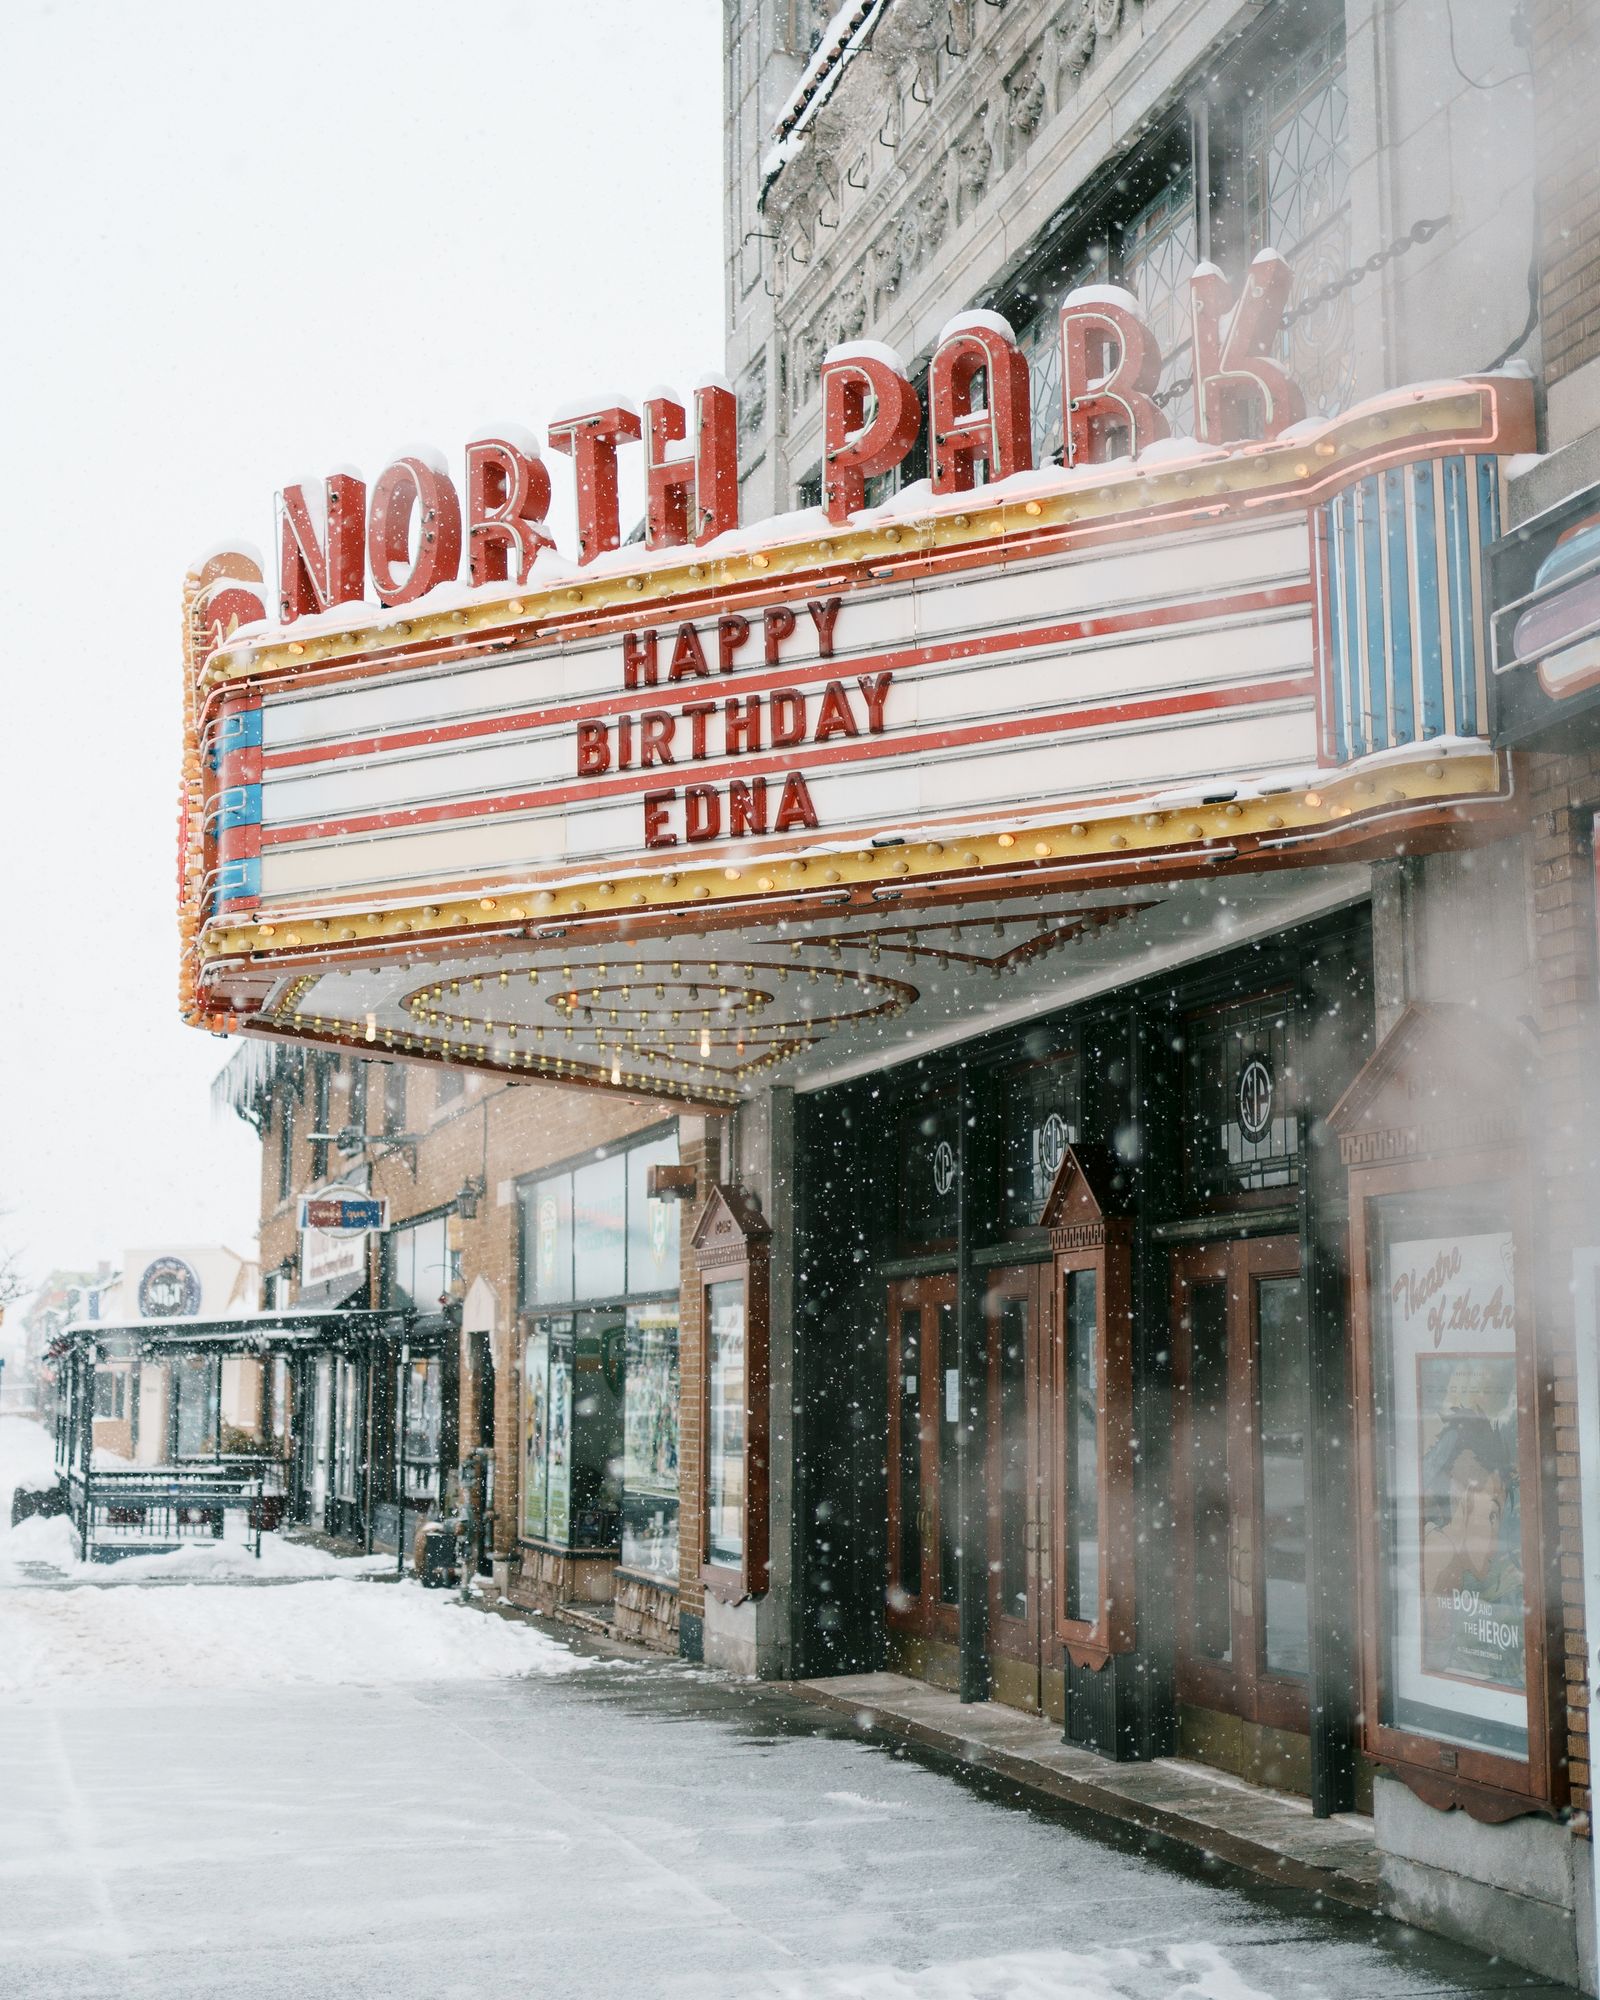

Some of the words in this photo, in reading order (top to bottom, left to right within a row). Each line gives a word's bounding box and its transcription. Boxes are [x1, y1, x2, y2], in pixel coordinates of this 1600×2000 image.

[274, 385, 739, 626] NORTH
[821, 257, 1307, 526] PARK
[622, 597, 842, 690] HAPPY
[576, 671, 893, 777] BIRTHDAY
[643, 771, 819, 849] EDNA
[1392, 1246, 1462, 1321] Theatre
[1427, 1294, 1446, 1349] of
[1447, 1287, 1481, 1331] the
[1436, 1596, 1453, 1610] THE
[1452, 1588, 1480, 1617] BOY
[1478, 1603, 1493, 1617] AND
[1463, 1621, 1478, 1636] THE
[1478, 1618, 1520, 1651] HERON
